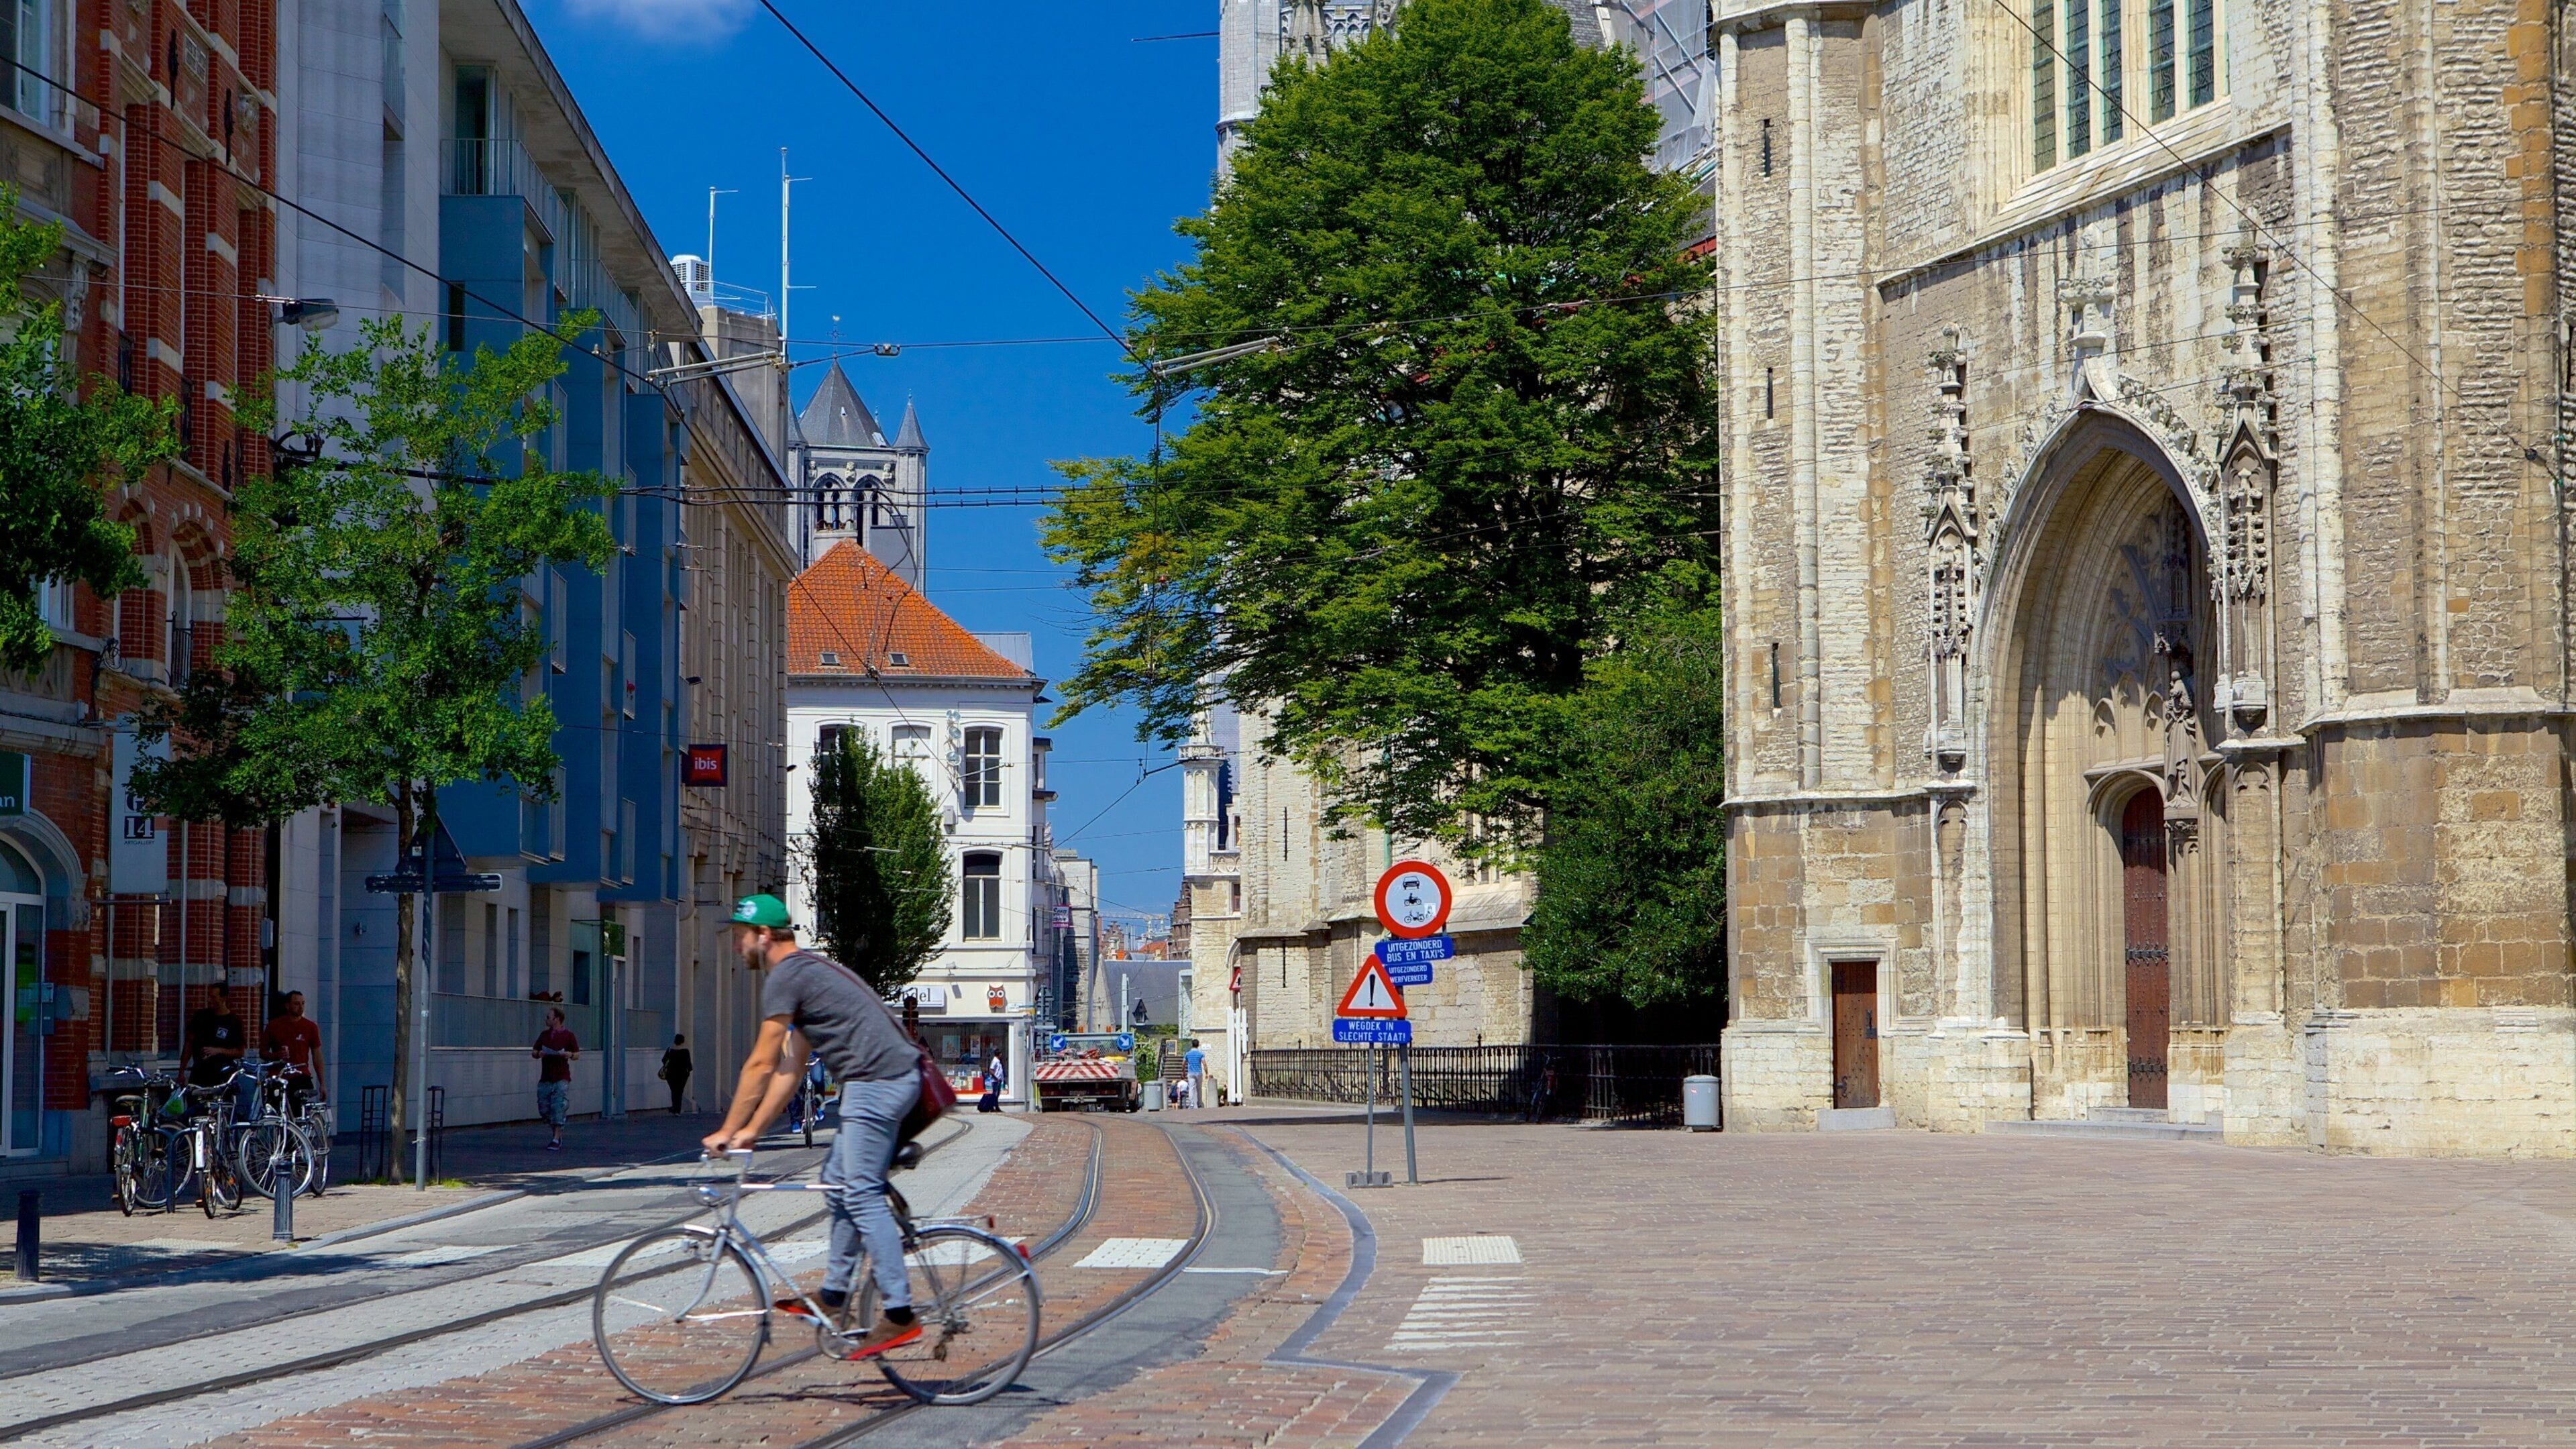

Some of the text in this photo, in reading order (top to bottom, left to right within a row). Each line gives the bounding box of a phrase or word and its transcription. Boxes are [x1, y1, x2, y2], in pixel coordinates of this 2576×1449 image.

[694, 757, 717, 770] ibis
[126, 817, 154, 838] 14
[1387, 939, 1442, 953] UITGEZONDERD
[1387, 949, 1445, 963] BUS EN TAXI'S
[1389, 965, 1427, 974] UITGEZONDERD
[1389, 974, 1428, 983] WERFVERKEER
[1348, 1021, 1393, 1030] WEGDEK IN
[1338, 1031, 1405, 1041] SLECHTE STAAT!
